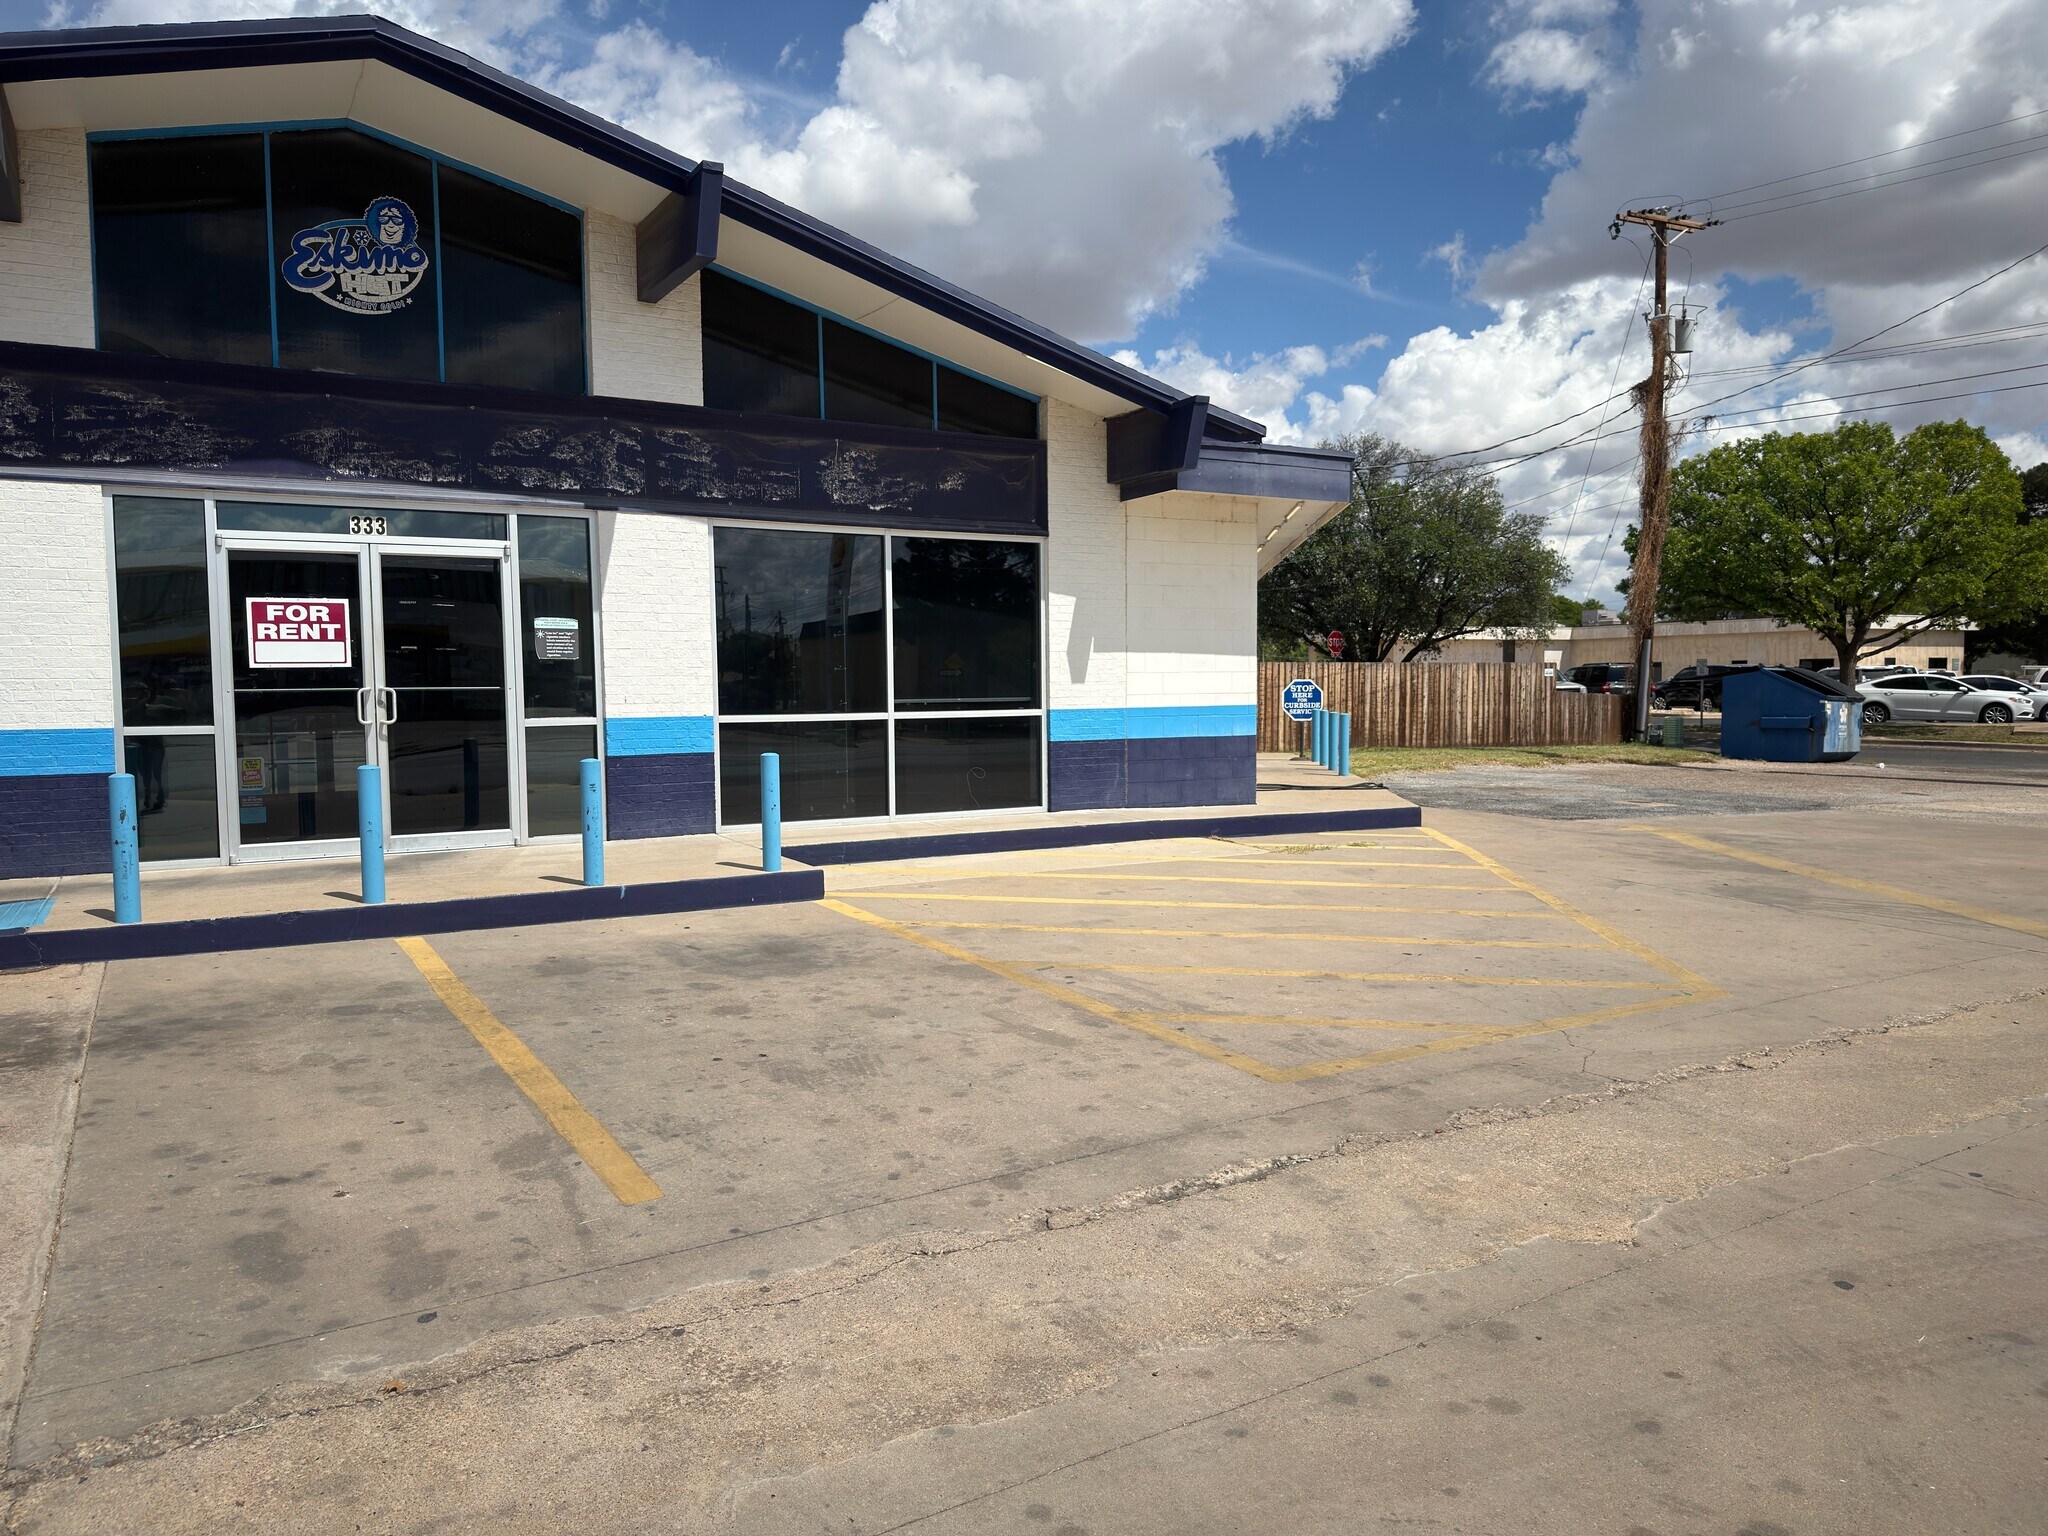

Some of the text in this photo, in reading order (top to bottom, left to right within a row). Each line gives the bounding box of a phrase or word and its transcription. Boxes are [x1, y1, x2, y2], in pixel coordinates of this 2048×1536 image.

[282, 228, 429, 292] Eskimo
[340, 273, 409, 296] HUT
[344, 297, 377, 311] MIGHTY
[351, 515, 386, 535] 333
[266, 604, 330, 621] FOR
[257, 623, 341, 640] RENT
[1329, 638, 1344, 647] STOP
